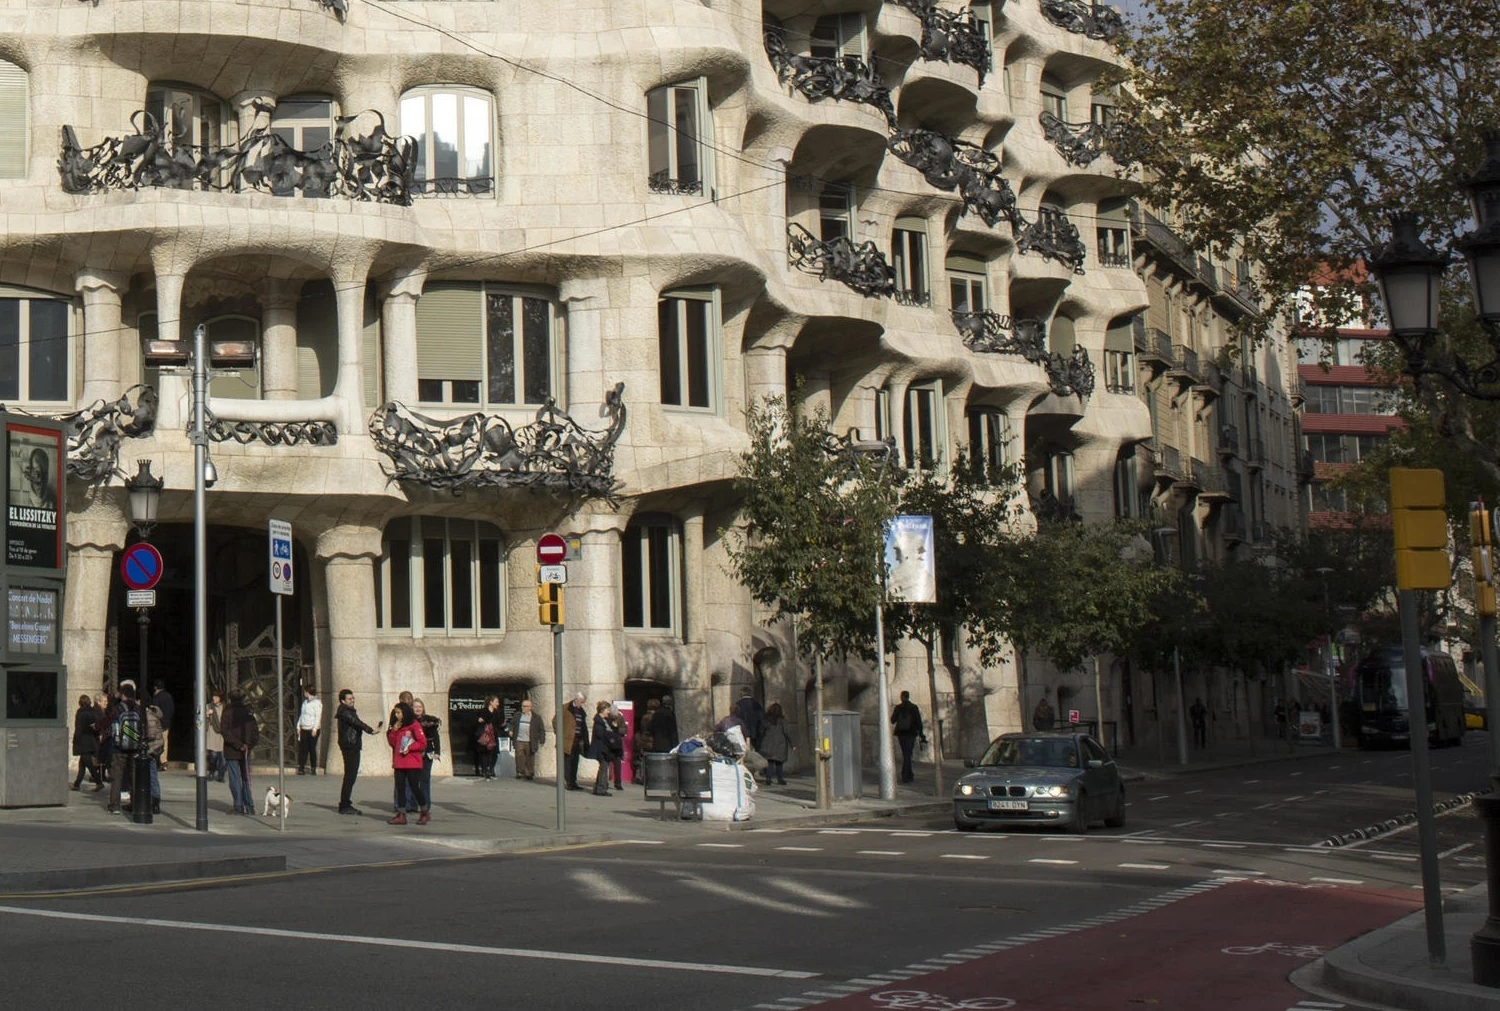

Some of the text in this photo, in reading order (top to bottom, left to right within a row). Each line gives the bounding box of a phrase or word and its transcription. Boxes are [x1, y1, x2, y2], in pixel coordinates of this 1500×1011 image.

[9, 507, 57, 524] EL LISSITZKY
[449, 702, 458, 711] La
